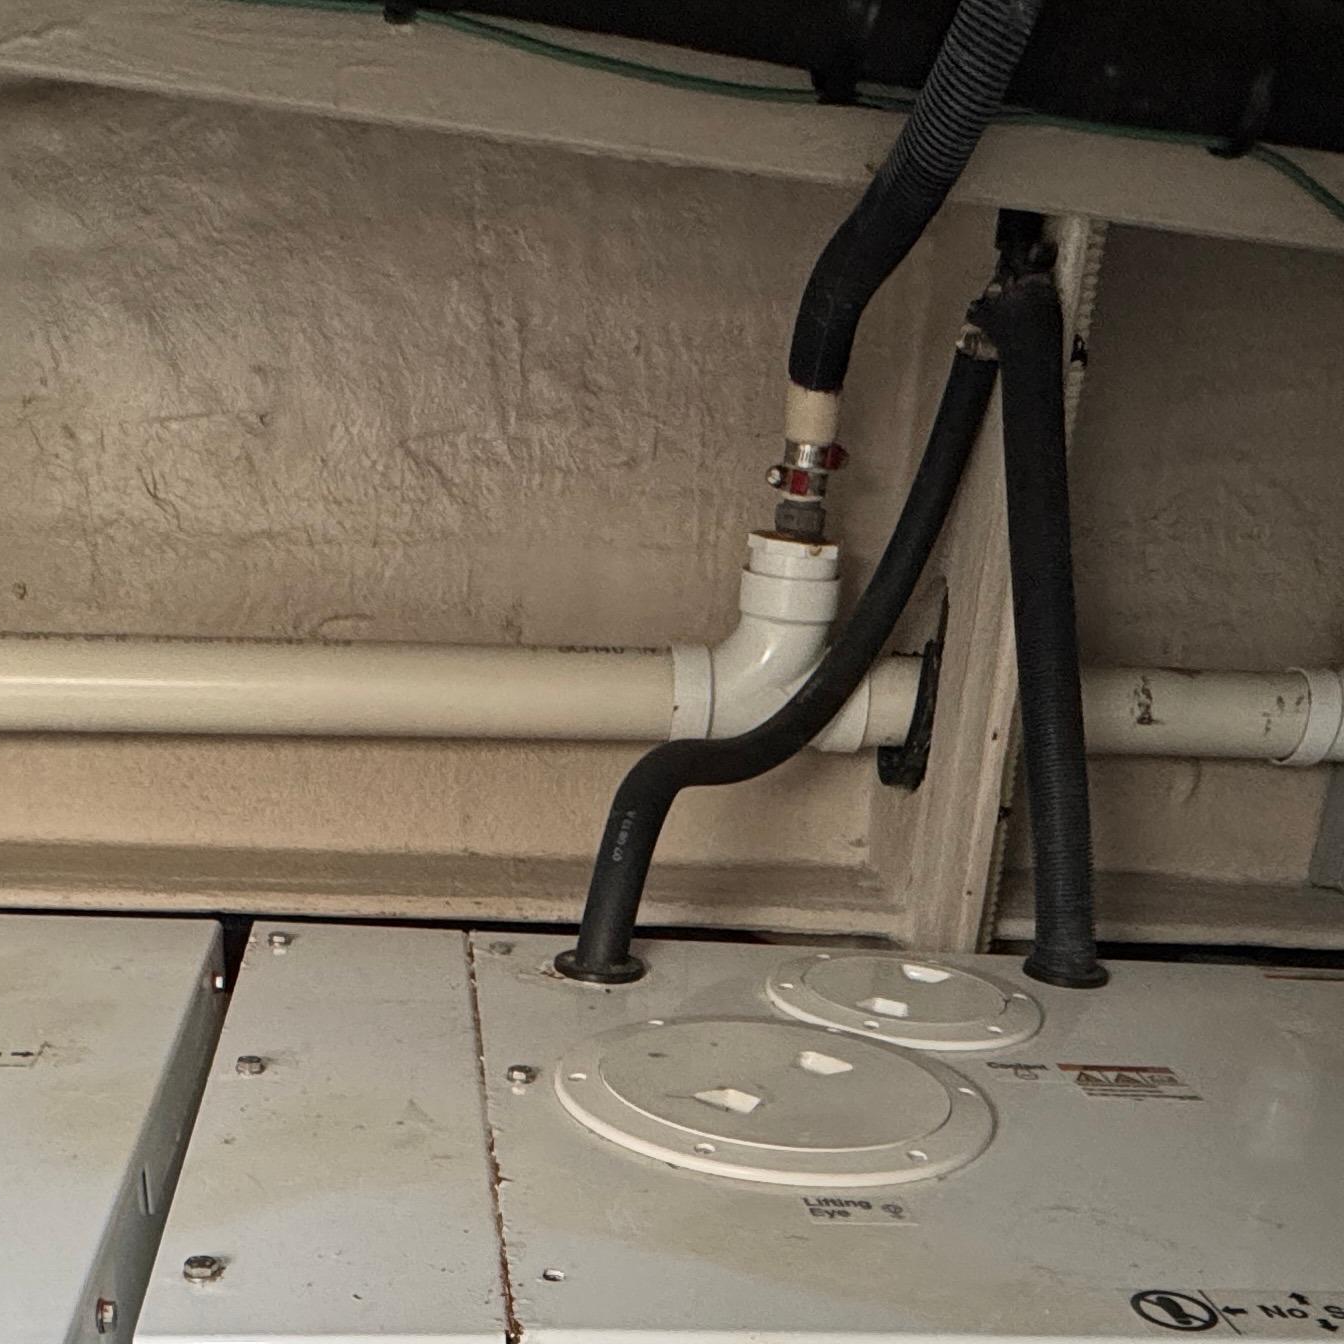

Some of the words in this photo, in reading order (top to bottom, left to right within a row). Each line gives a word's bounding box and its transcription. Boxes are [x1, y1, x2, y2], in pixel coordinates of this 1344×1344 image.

[803, 1197, 872, 1210] Lifting
[809, 1207, 850, 1219] Eye
[1257, 1304, 1309, 1319] No
